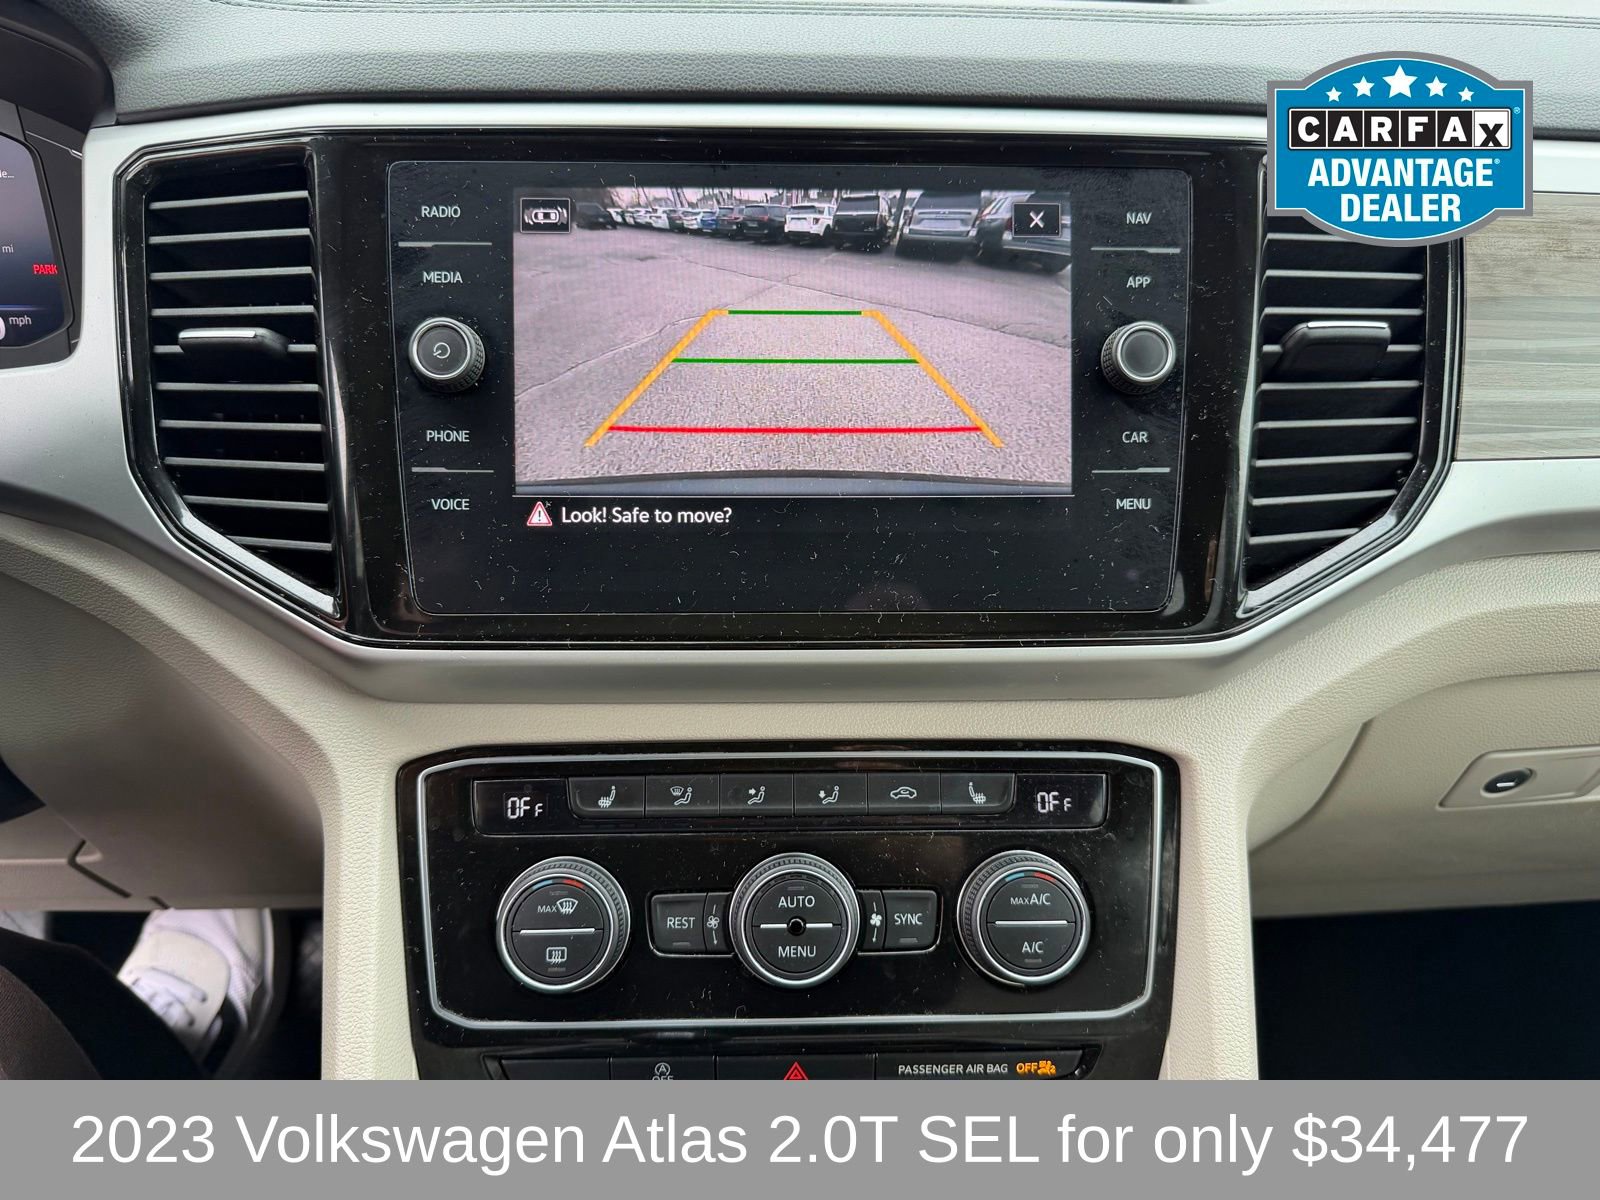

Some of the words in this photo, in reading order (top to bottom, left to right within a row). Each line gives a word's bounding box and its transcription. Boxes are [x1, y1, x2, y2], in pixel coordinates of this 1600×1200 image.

[421, 206, 461, 218] RADIO
[1126, 212, 1152, 225] NAV
[33, 264, 58, 275] PARK
[423, 271, 463, 284] MEDIA
[1126, 276, 1151, 289] APP
[9, 315, 32, 327] mph
[426, 430, 470, 443] PHONE
[1122, 431, 1148, 443] CAR
[431, 498, 470, 511] VOICE
[1116, 498, 1151, 510] MENU
[561, 507, 607, 523] Look!
[612, 507, 650, 523] Safe
[654, 509, 673, 523] to
[677, 508, 733, 523] move?
[778, 895, 815, 908] AUTO
[537, 905, 558, 913] MAX
[667, 917, 696, 929] REST
[894, 913, 923, 925] SYNC
[778, 945, 816, 957] MENU
[1022, 942, 1044, 953] A/C
[898, 1064, 964, 1075] PASSENGER
[966, 1063, 984, 1074] AIR
[986, 1063, 1008, 1074] BAG
[1016, 1062, 1038, 1074] OFF
